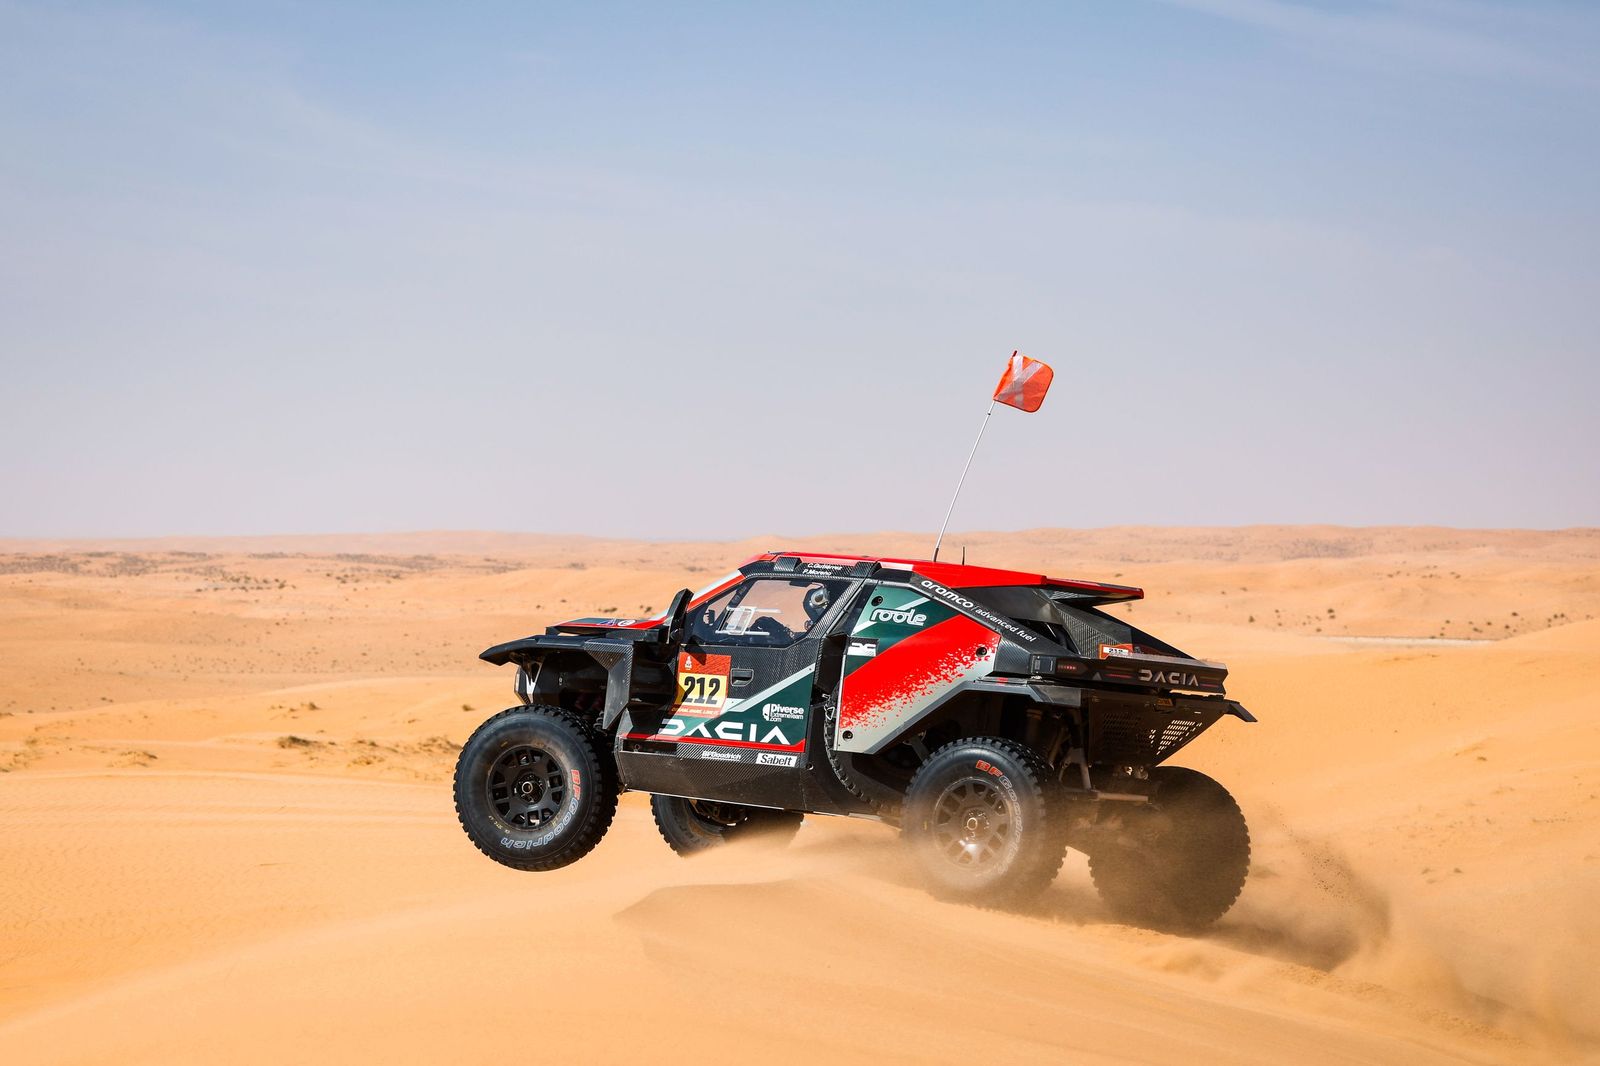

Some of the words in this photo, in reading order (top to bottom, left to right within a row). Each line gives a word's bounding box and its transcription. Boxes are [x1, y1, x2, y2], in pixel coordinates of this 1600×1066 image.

[870, 608, 927, 627] roole
[920, 580, 975, 609] aramco
[975, 608, 1018, 632] advanced
[1017, 630, 1037, 642] fuel
[1138, 669, 1199, 687] DACIA
[681, 676, 721, 705] 212
[770, 703, 804, 715] Diverse
[657, 718, 791, 745] DACIA
[760, 754, 793, 767] Sabelt
[500, 769, 581, 850] BFGoodrich
